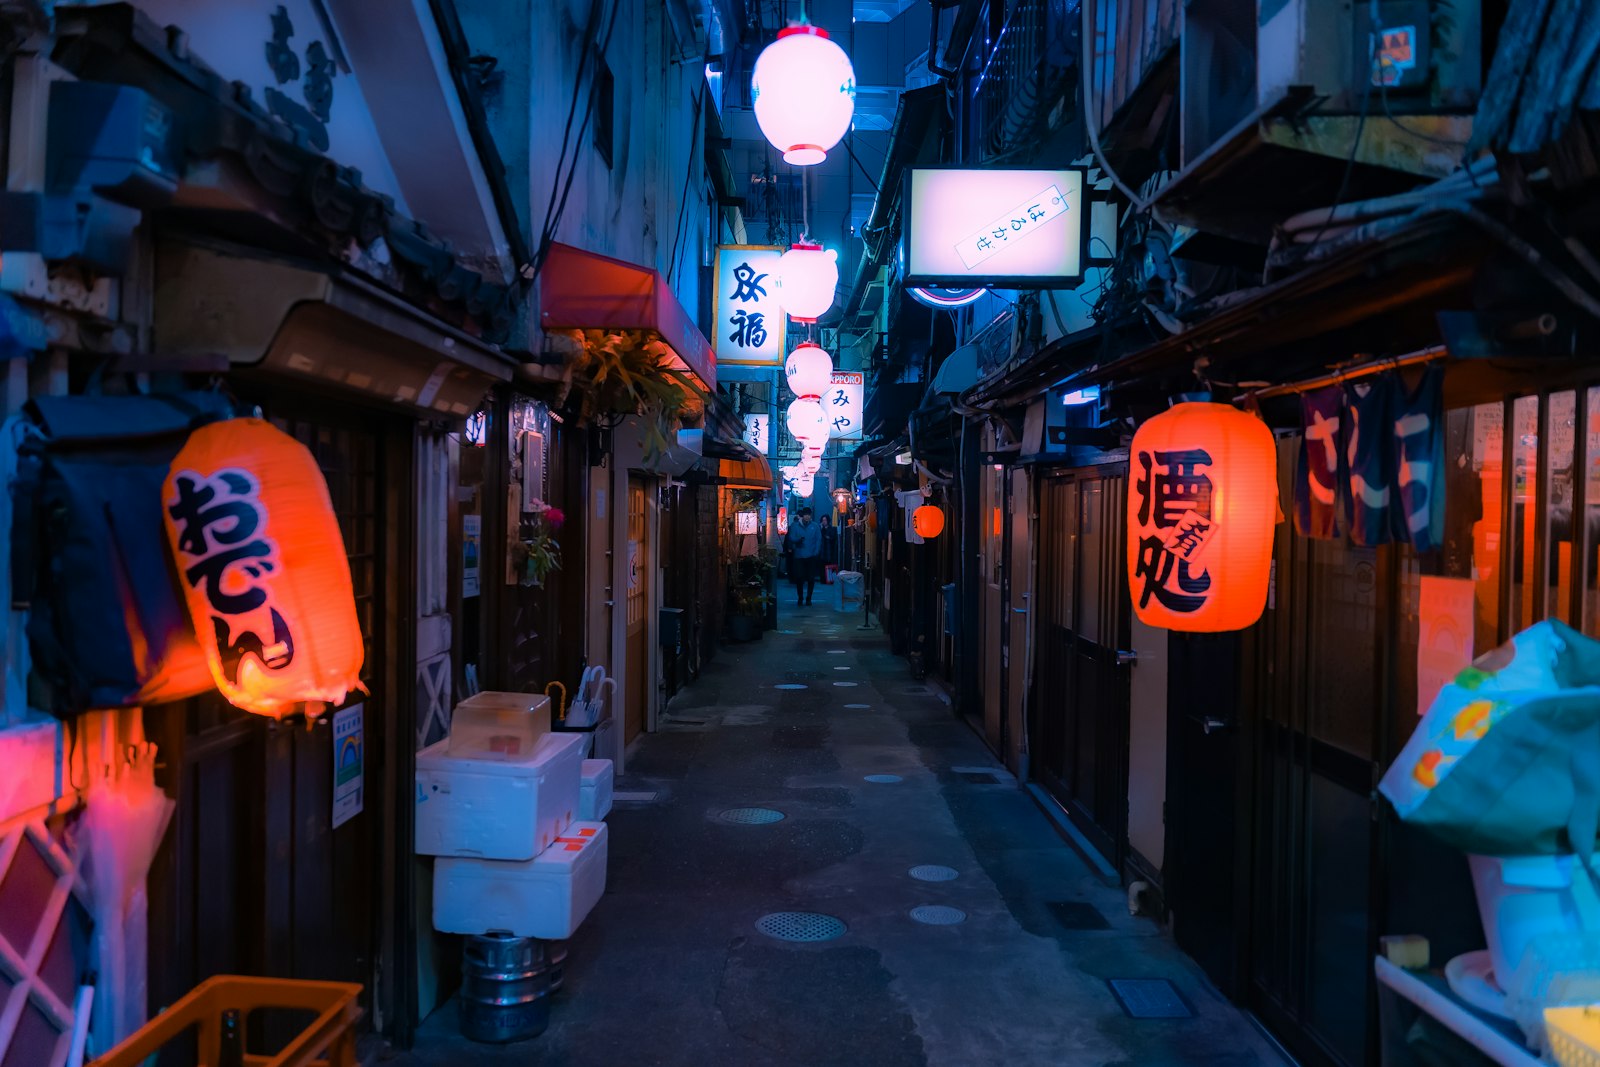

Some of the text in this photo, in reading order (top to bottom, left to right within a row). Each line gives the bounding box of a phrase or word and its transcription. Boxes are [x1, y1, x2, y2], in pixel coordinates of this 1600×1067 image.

[975, 203, 1046, 252] はるかぜ
[832, 389, 851, 432] みや
[168, 472, 294, 685] おでん
[1135, 448, 1213, 613] 酒処
